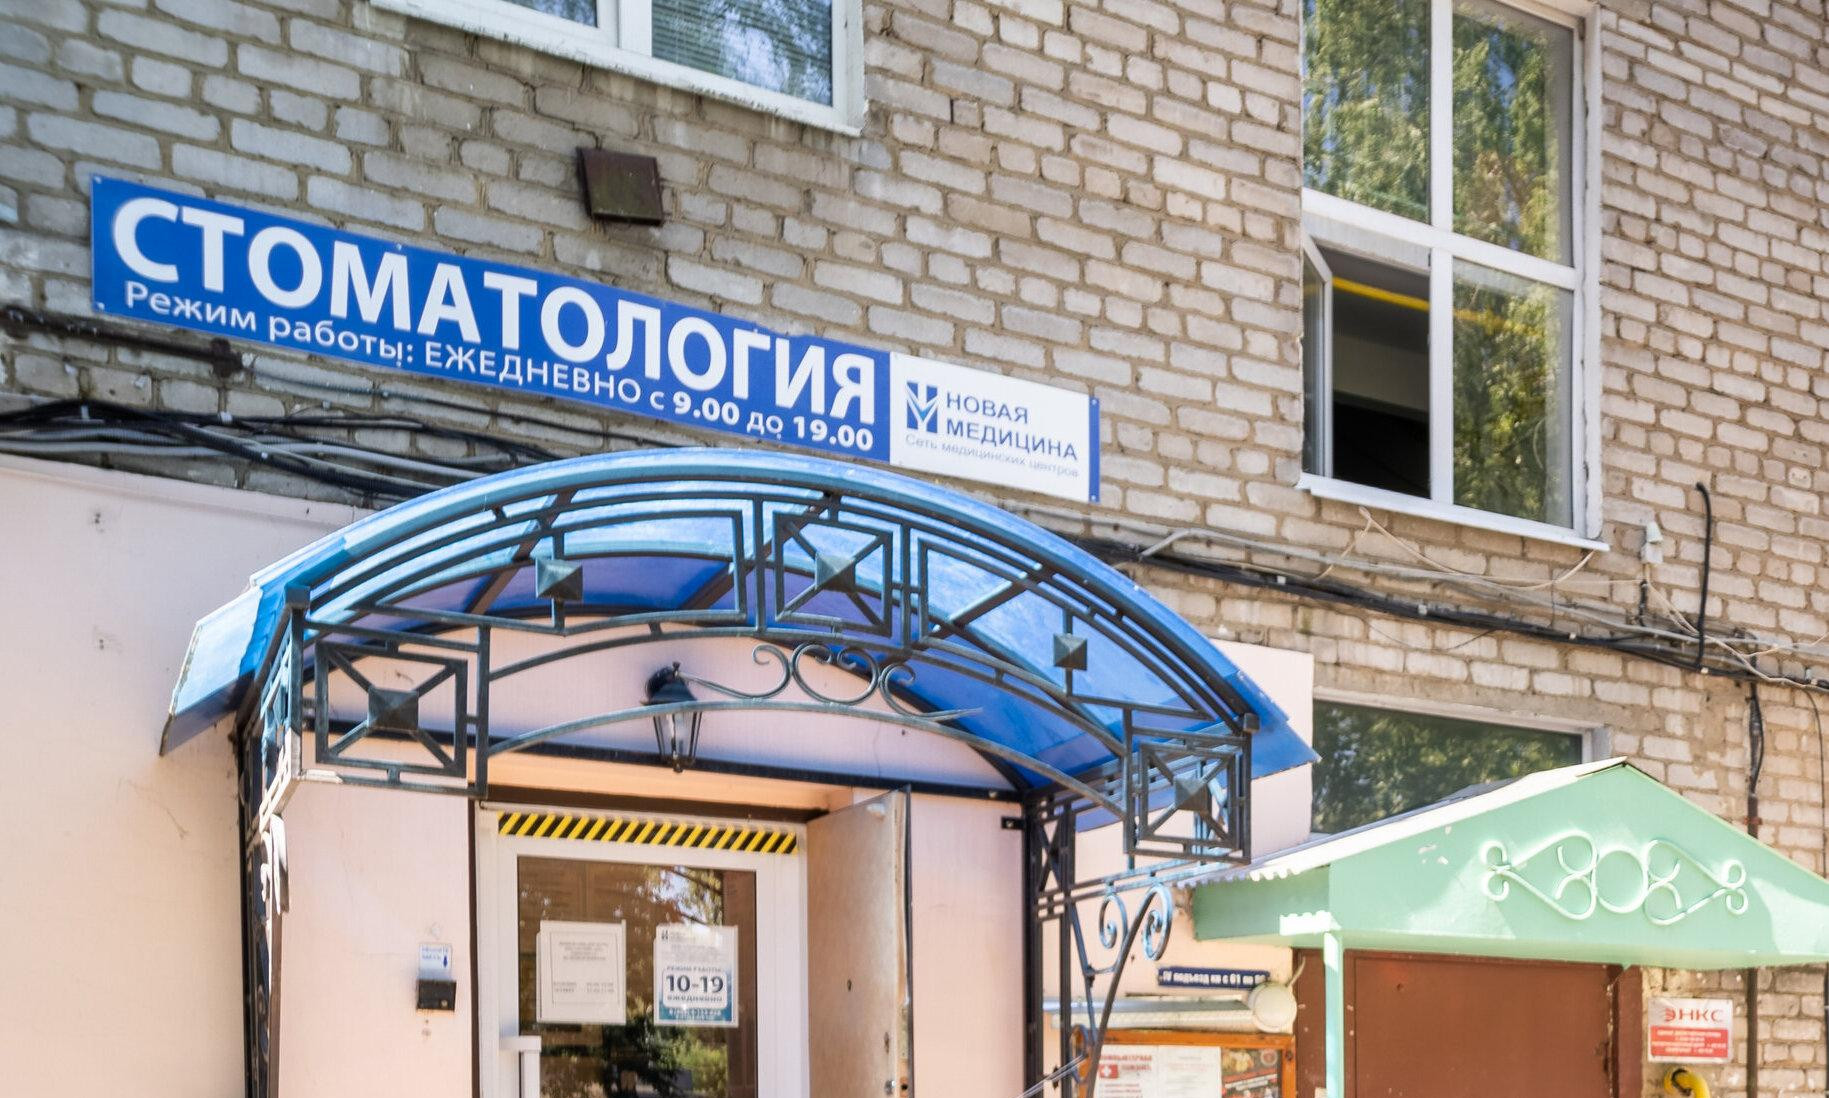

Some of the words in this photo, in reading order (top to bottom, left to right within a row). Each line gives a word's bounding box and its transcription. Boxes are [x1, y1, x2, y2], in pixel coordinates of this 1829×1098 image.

[112, 197, 875, 424] СТОМАТОЛОГИЯ
[125, 281, 257, 333] Режим
[269, 315, 413, 362] работы:
[425, 343, 641, 403] ЕЖЕДНЕВНО
[649, 391, 665, 410] с
[673, 390, 740, 425] 9.00
[747, 412, 784, 436] до
[793, 416, 873, 451] 19.00
[946, 391, 1029, 425] НОВАЯ
[905, 433, 938, 451] Сеть
[941, 442, 1026, 467] медицинских
[1029, 460, 1080, 478] центров
[946, 418, 1078, 461] МЕДИЦИНА
